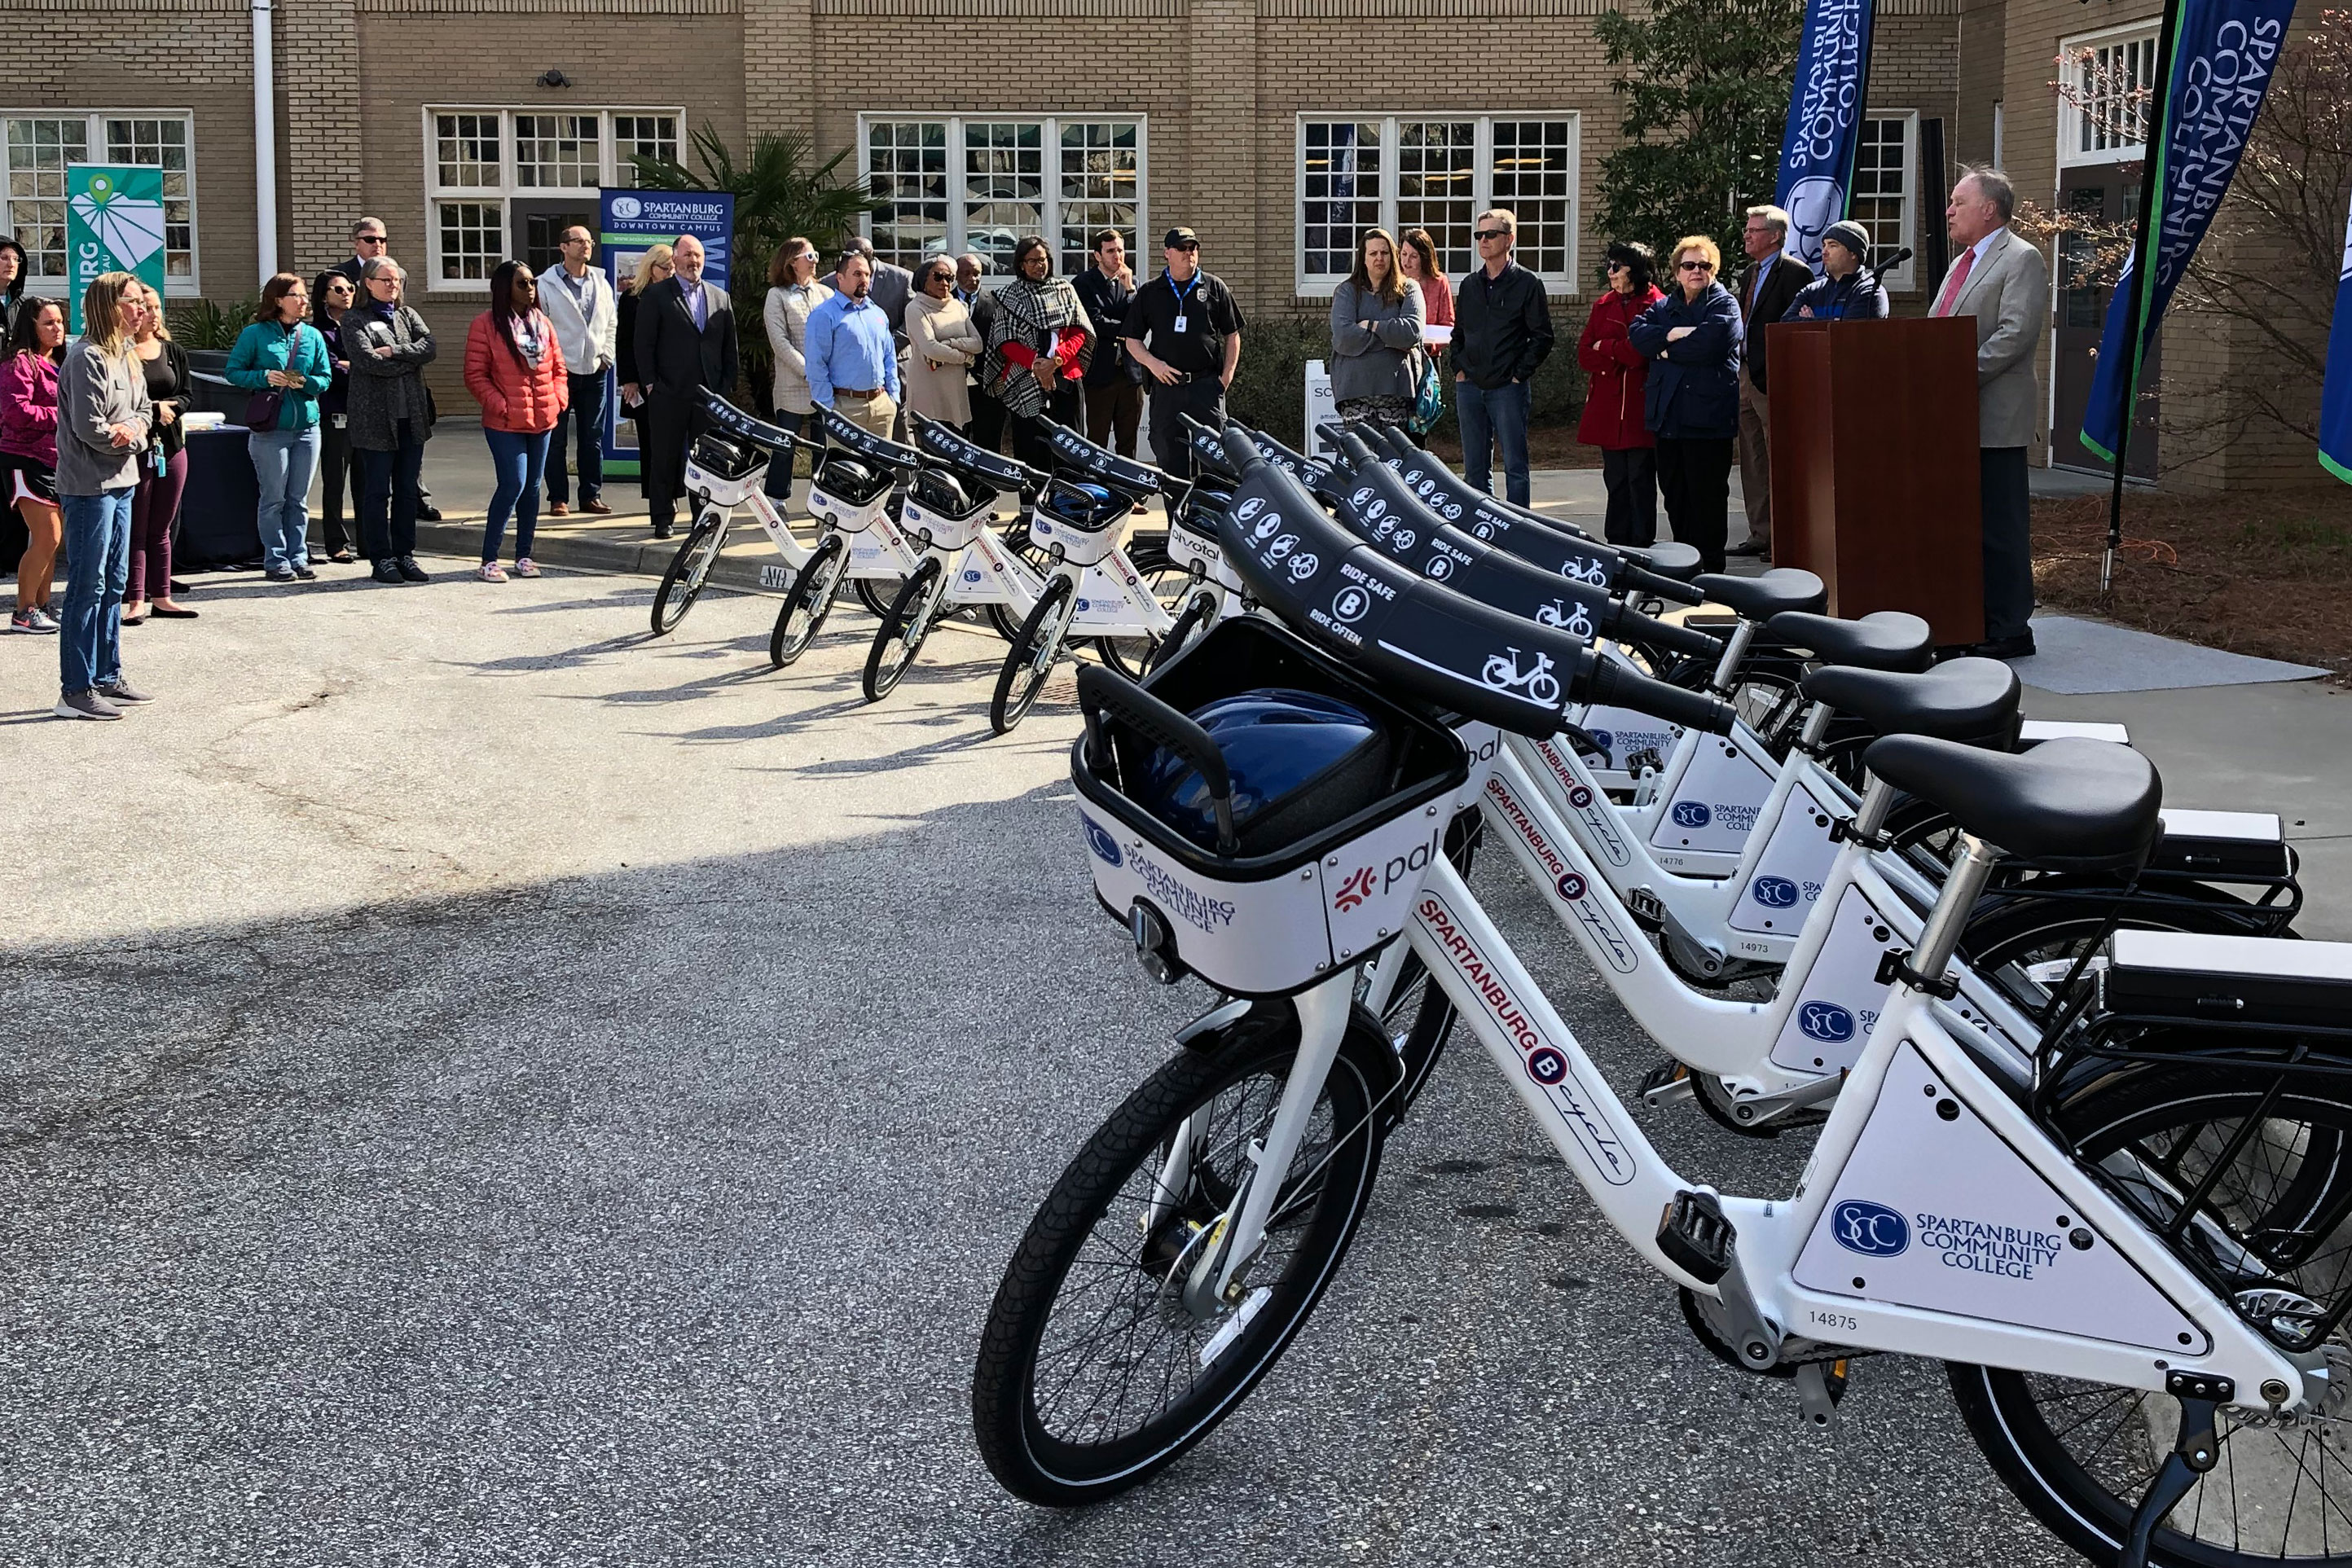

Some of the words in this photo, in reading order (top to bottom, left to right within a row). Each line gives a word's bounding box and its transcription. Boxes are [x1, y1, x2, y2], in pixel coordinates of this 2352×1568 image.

[1809, 0, 1844, 160] COMMUNI
[644, 202, 723, 214] SPARTANBURG
[614, 222, 675, 231] DOWNTOWN
[680, 224, 721, 232] CAMPUS
[1475, 508, 1493, 521] RIDE
[1491, 516, 1511, 531] SAFE
[1172, 529, 1220, 560] pivotal
[1431, 538, 1451, 555] RIDE
[1450, 549, 1473, 566] SAFE
[1340, 563, 1369, 584] RIDE
[1366, 578, 1397, 602] SAFE
[1339, 592, 1361, 615] B
[1310, 608, 1334, 627] RIDE
[1331, 622, 1363, 646] OFTEN
[1615, 731, 1672, 741] SPARTANBURG
[1617, 738, 1670, 748] COMMUNITY
[1717, 813, 1758, 823] COMMU
[1726, 821, 1752, 831] COLL
[1384, 828, 1439, 895] pal
[1487, 778, 1564, 876] SPARTANBURG
[1580, 899, 1627, 966] cycle
[1660, 858, 1684, 867] 14776
[1123, 843, 1235, 914] SPARTANBURG
[1129, 859, 1233, 926] COMMUNITY
[1146, 883, 1214, 934] COLLEGE
[1740, 942, 1769, 953] 14973
[1419, 899, 1538, 1052] SPARTANBURG
[1559, 1084, 1621, 1176] cycle
[1916, 1213, 2062, 1251] SPARTANBURG
[1921, 1232, 2057, 1267] COMMUNITY
[1941, 1251, 2034, 1280] COLLEGE
[1809, 1311, 1857, 1331] 14875
